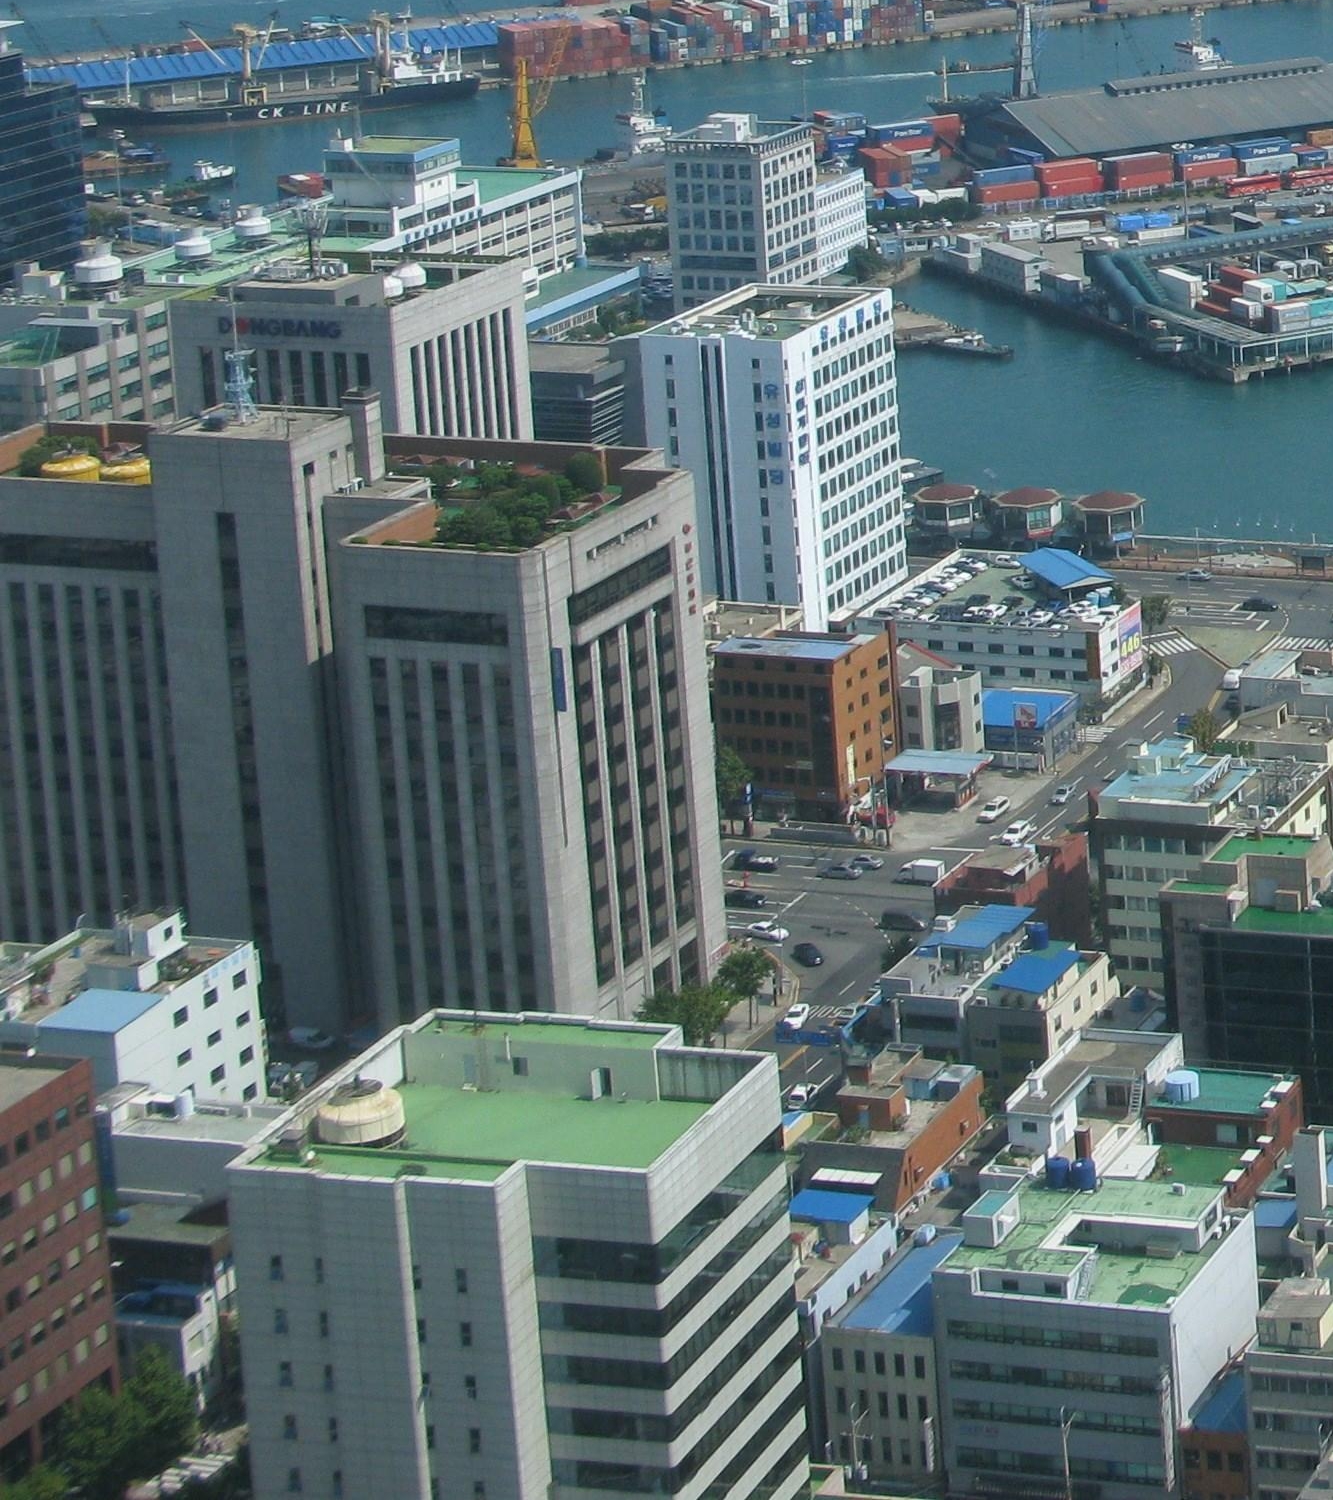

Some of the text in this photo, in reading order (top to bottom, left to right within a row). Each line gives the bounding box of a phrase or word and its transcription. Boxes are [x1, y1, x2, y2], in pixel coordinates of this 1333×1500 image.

[258, 106, 284, 119] CK
[303, 101, 350, 116] LINE
[218, 316, 341, 338] DONGBANG
[763, 383, 785, 486] 유성빌딩
